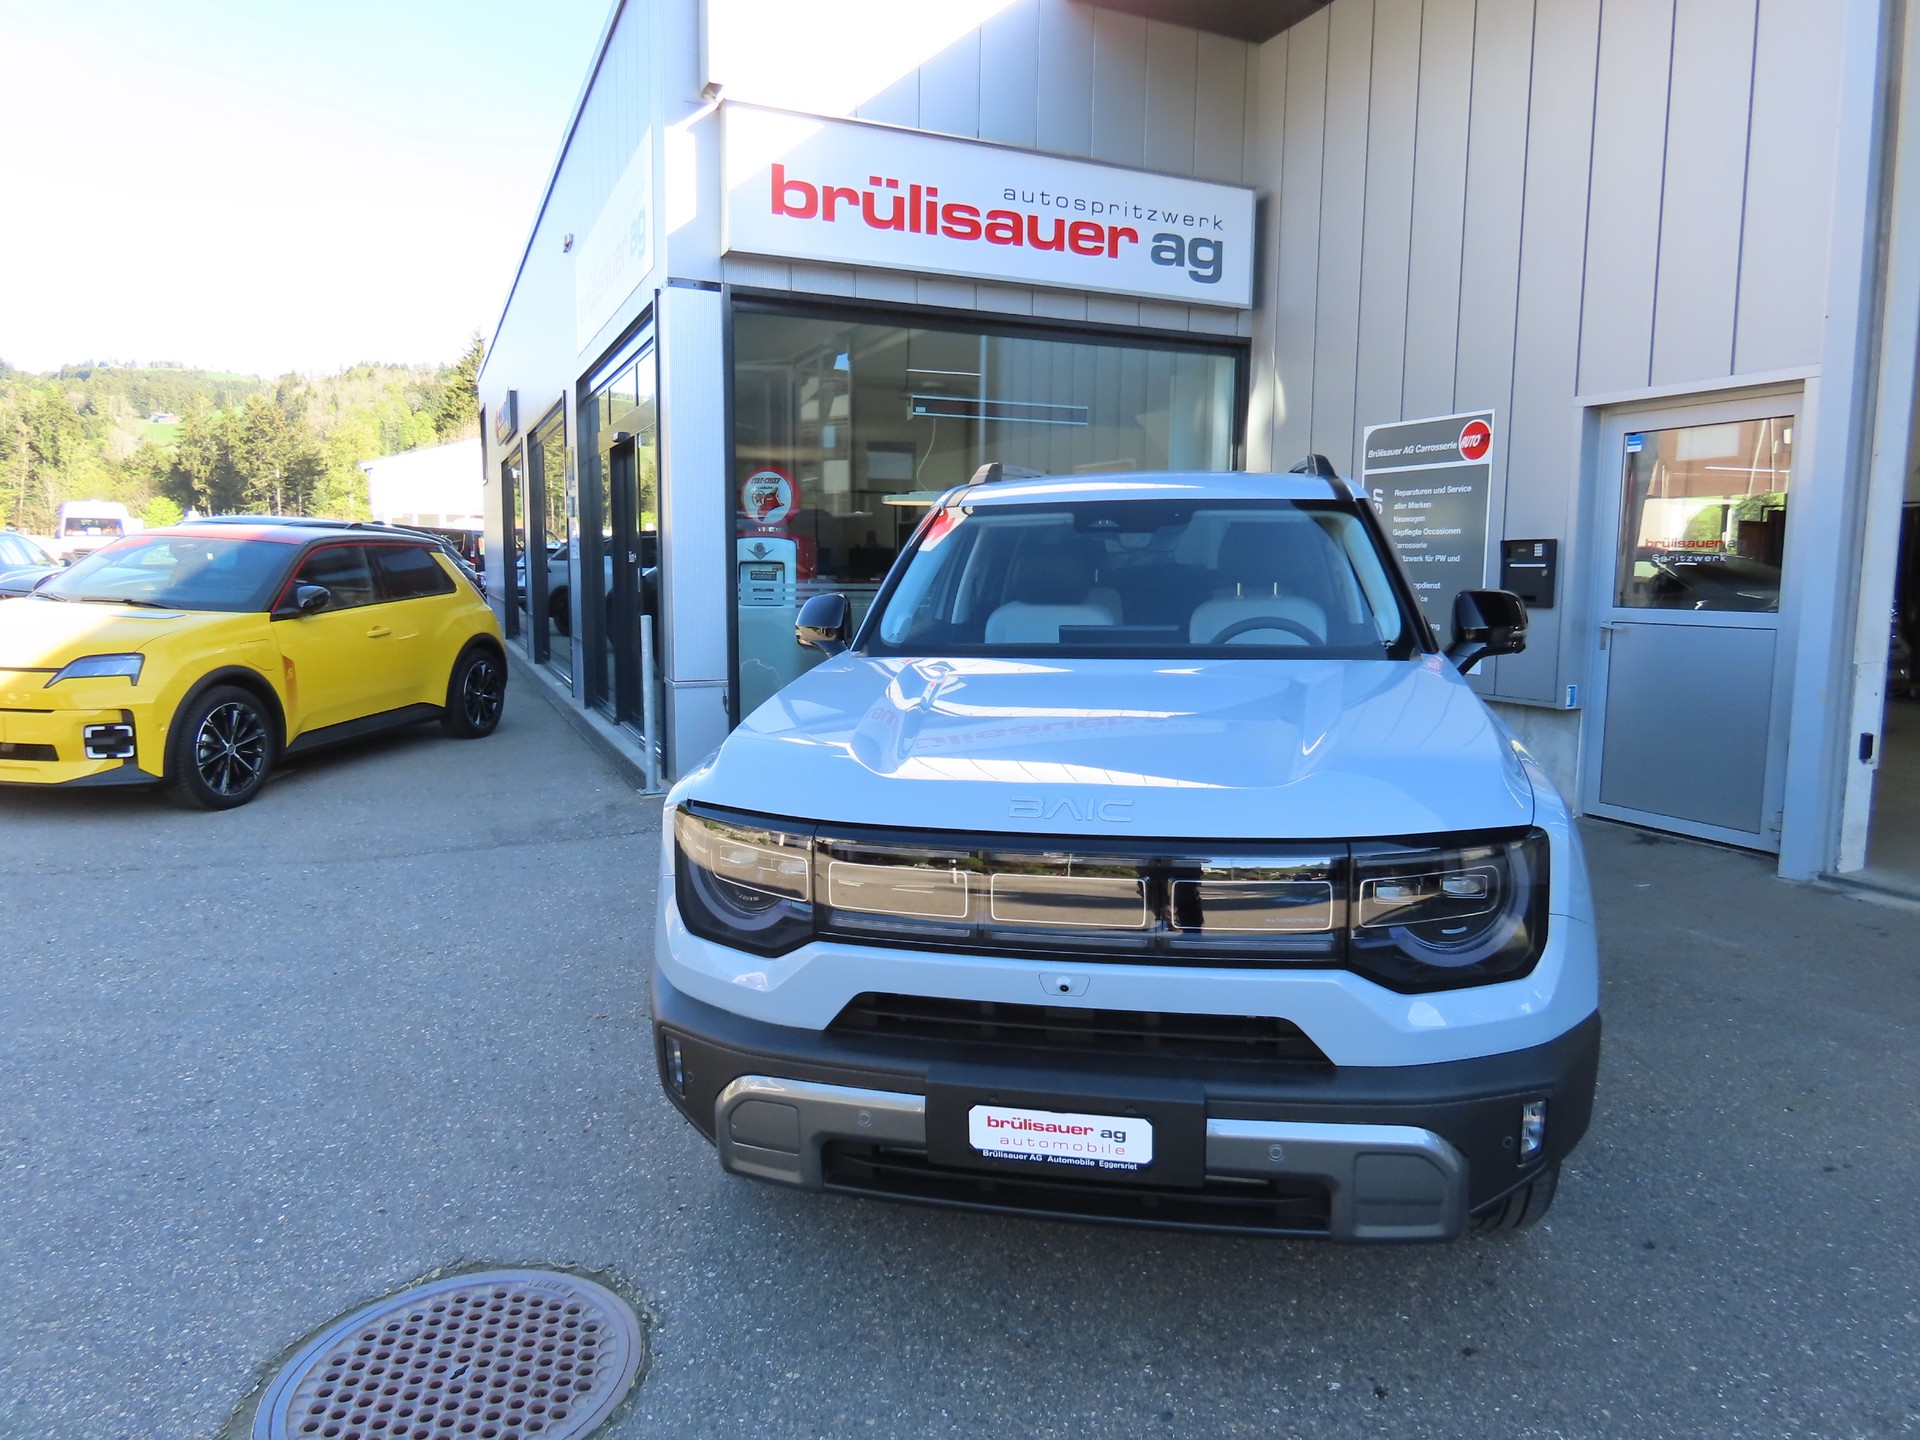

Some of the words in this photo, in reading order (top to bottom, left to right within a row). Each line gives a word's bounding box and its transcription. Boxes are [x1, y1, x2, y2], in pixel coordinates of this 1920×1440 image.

[1003, 185, 1224, 231] autospritzwerk
[770, 163, 1139, 259] brülisauer
[1150, 232, 1223, 284] ag
[1368, 447, 1402, 459] Brülisauer
[1403, 445, 1414, 454] AG
[1416, 441, 1458, 453] Carrosserie
[1394, 488, 1432, 498] Reparaturen
[1433, 487, 1446, 495] und
[1447, 484, 1472, 493] Service
[1393, 502, 1407, 510] aller
[1408, 501, 1432, 509] Marken
[1393, 515, 1425, 524] Neuwagen
[1392, 528, 1422, 537] Gepflegte
[1423, 527, 1461, 536] Occasionen
[1395, 541, 1428, 549] arrosserie
[1645, 538, 1724, 549] brülisauer
[1424, 554, 1434, 562] für
[1435, 554, 1447, 562] PW
[1447, 554, 1461, 562] und
[1652, 553, 1727, 563] Spritzwerk
[1008, 796, 1135, 823] BAIC
[987, 1116, 1094, 1136] brülisauer
[1100, 1128, 1126, 1143] ag
[1000, 1136, 1125, 1155] automobile
[982, 1149, 1028, 1161] Brülisauer
[1029, 1154, 1043, 1162] AG
[1047, 1155, 1095, 1166] Automobile
[1099, 1159, 1138, 1171] Eggersriet
